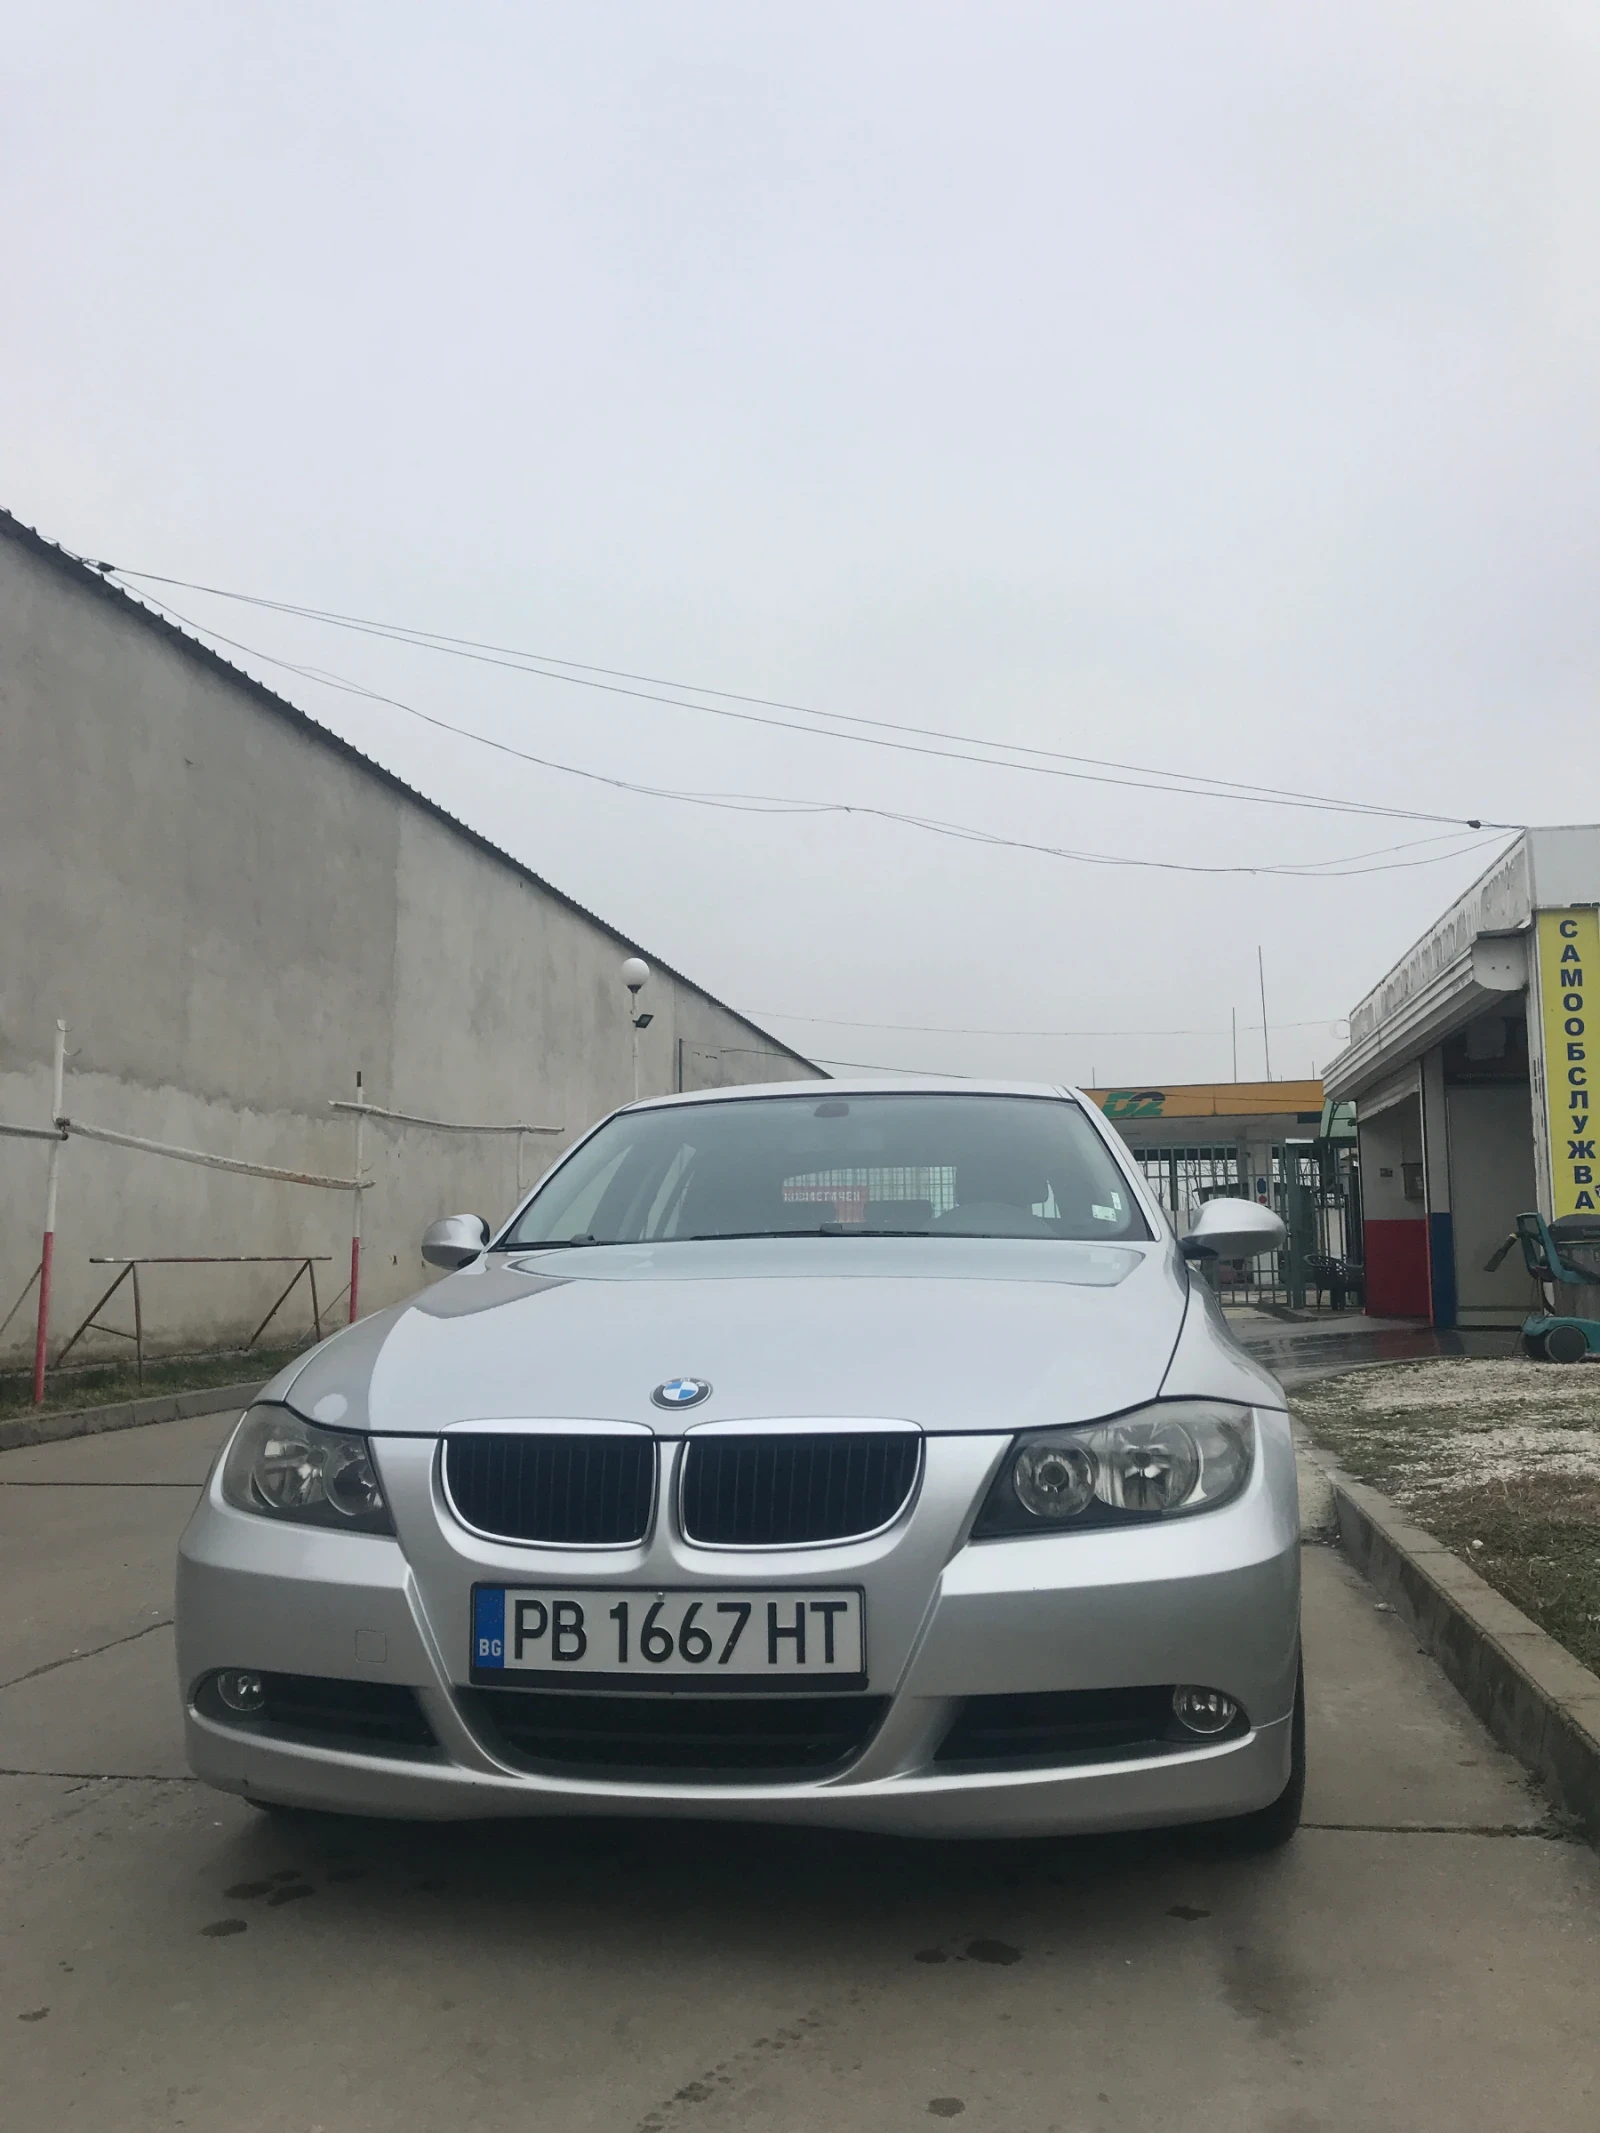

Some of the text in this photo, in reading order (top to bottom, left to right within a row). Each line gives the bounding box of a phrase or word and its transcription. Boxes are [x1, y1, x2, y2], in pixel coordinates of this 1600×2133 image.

[1102, 1091, 1166, 1118] D2
[514, 1599, 848, 1664] PB 1667 HT
[479, 1638, 502, 1657] BG
